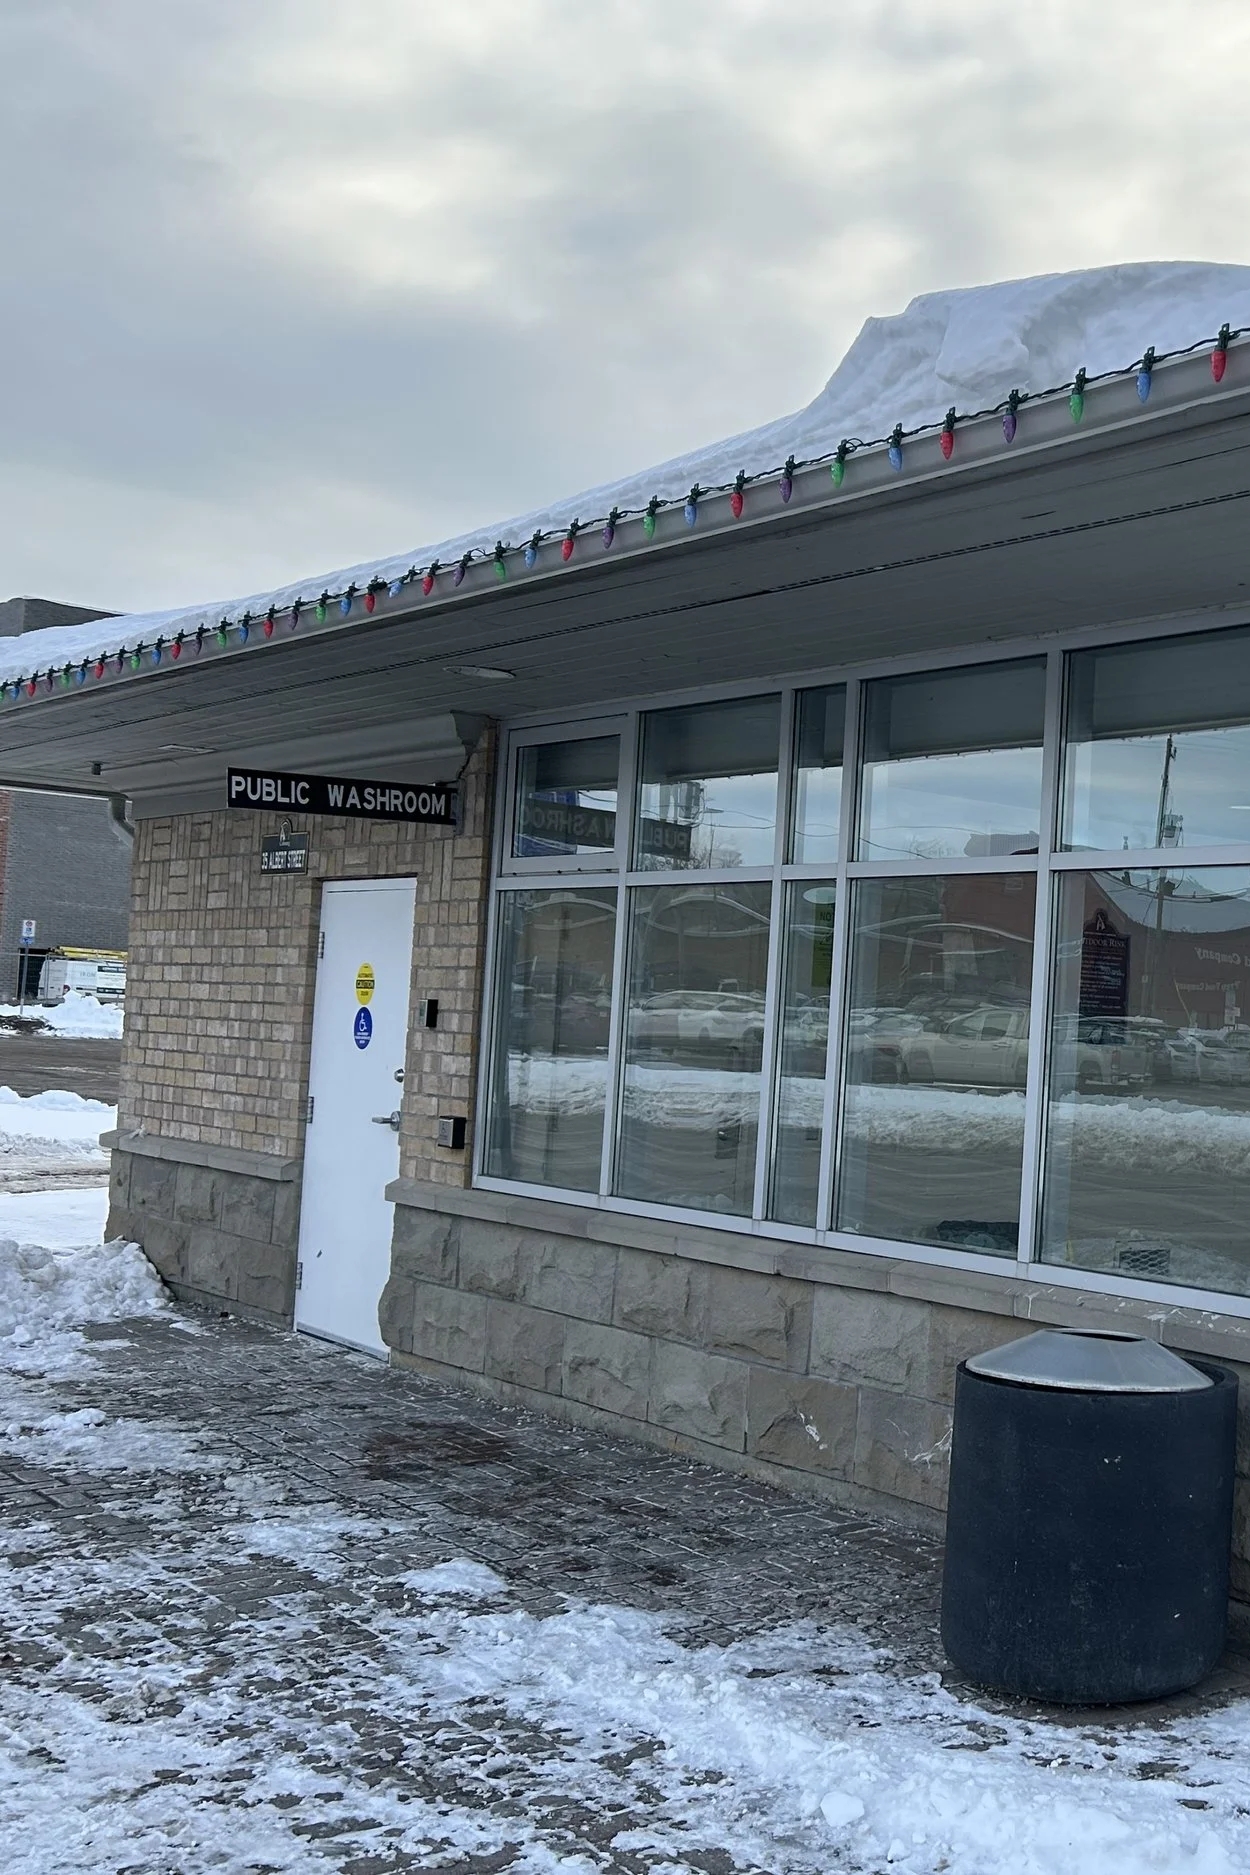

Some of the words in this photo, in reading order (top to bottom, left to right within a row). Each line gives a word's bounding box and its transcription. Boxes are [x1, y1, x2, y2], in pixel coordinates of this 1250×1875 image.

[231, 775, 310, 805] PUBLIC
[327, 783, 446, 816] WASHROOM
[261, 851, 268, 870] 35
[269, 850, 287, 869] ALBERT
[287, 849, 306, 868] STREET
